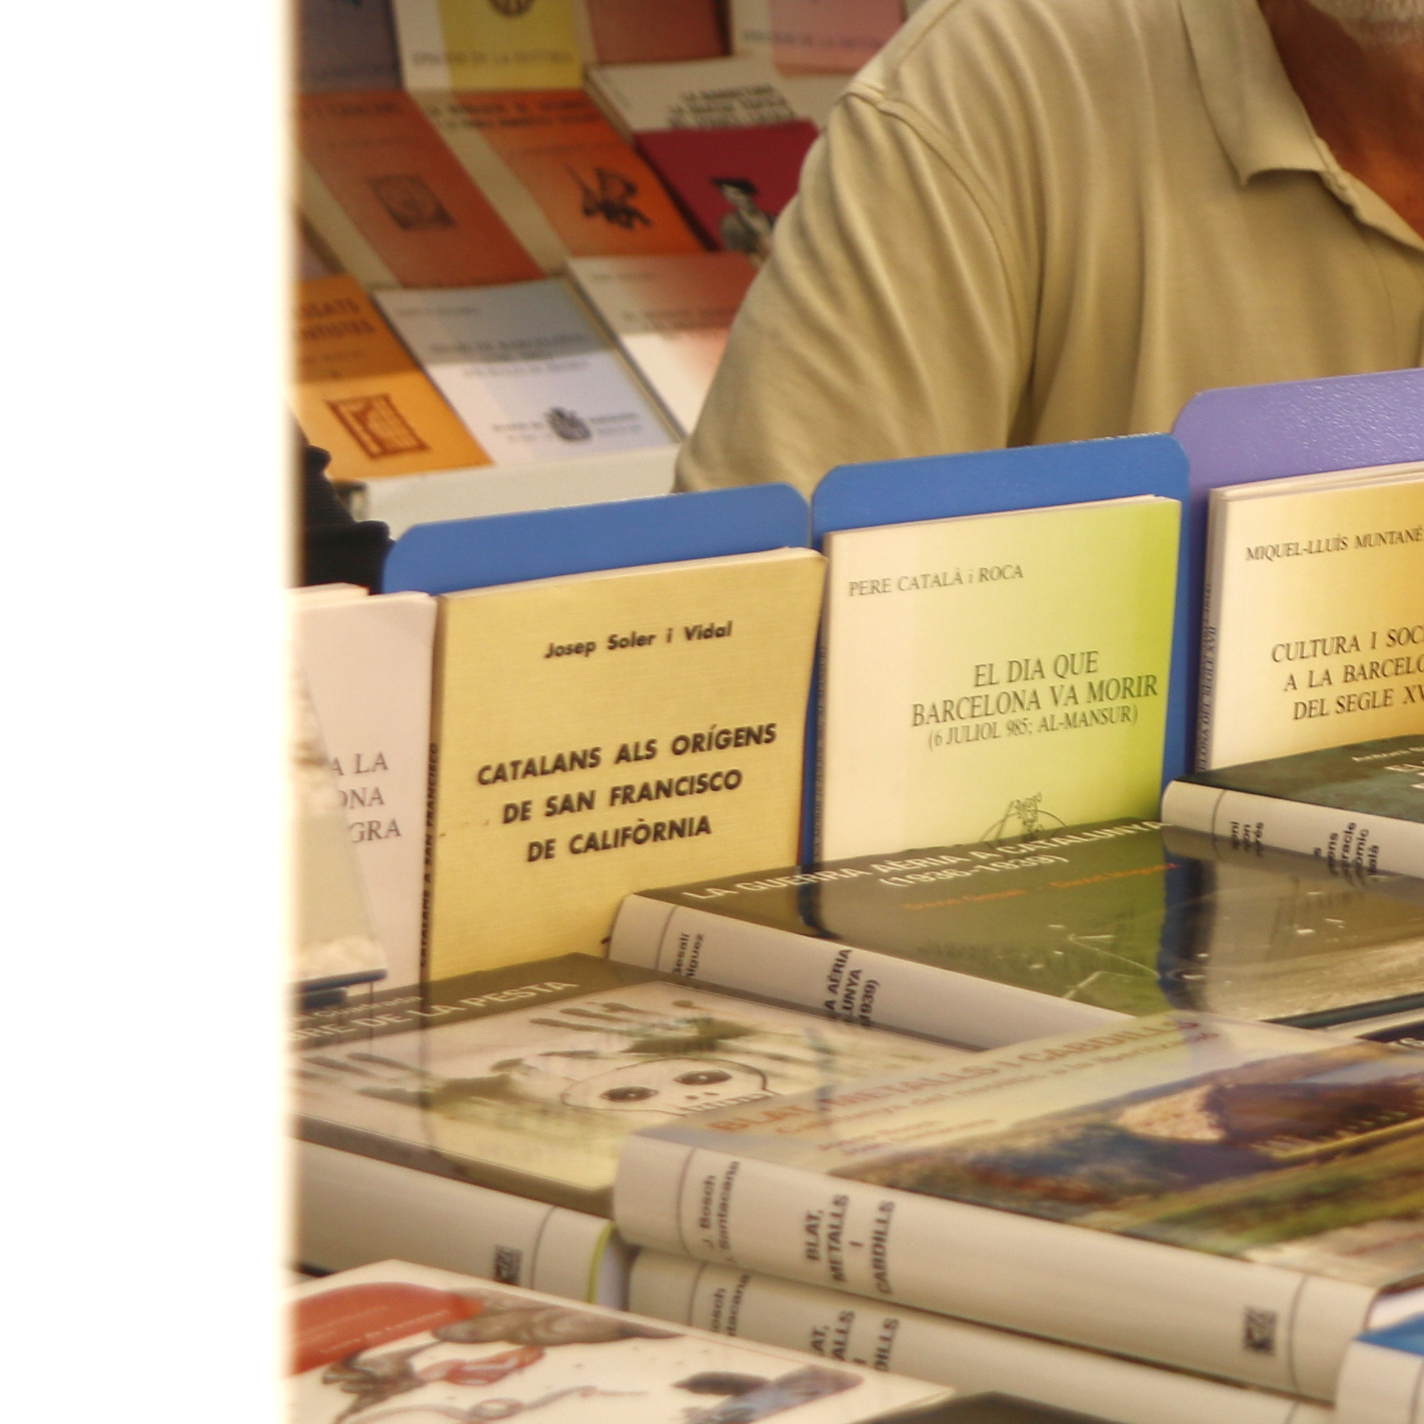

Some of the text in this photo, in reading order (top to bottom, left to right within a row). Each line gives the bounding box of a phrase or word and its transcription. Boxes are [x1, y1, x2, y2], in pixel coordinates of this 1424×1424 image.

[848, 578, 892, 598] PERE
[896, 567, 964, 593] CATALÀ
[978, 563, 1024, 583] ROCA
[544, 636, 598, 660] Josep
[607, 628, 656, 651] Soler
[683, 621, 733, 642] Vidal
[1270, 631, 1361, 664] CULTURA
[973, 649, 1100, 688] EL DIA QUE
[1283, 669, 1299, 693] A
[1307, 666, 1333, 689] LA
[911, 673, 1159, 728] BARCELONA VA MORIR
[1292, 698, 1330, 721] DEL
[1335, 687, 1395, 715] SEGLE
[928, 728, 944, 752] (6
[944, 722, 1002, 747] JULIOL
[1037, 704, 1139, 735] AL-MANSUR)
[354, 751, 389, 775] LA
[477, 721, 778, 789] CATALANS ALS ORÍGENS
[501, 768, 744, 826] DE SAN FRANCISCO
[526, 815, 713, 864] DE CALIFÒRNIA
[683, 886, 738, 900] LA
[738, 867, 874, 892] GUERRA
[968, 849, 996, 861] A
[995, 819, 1170, 855] CATALUNYA
[877, 853, 1070, 888] (1936-1939)
[458, 980, 581, 1007] PESTA
[804, 1208, 826, 1262] BLAT,
[826, 1193, 850, 1283] METALLS
[871, 1199, 896, 1295] CABDILLS
